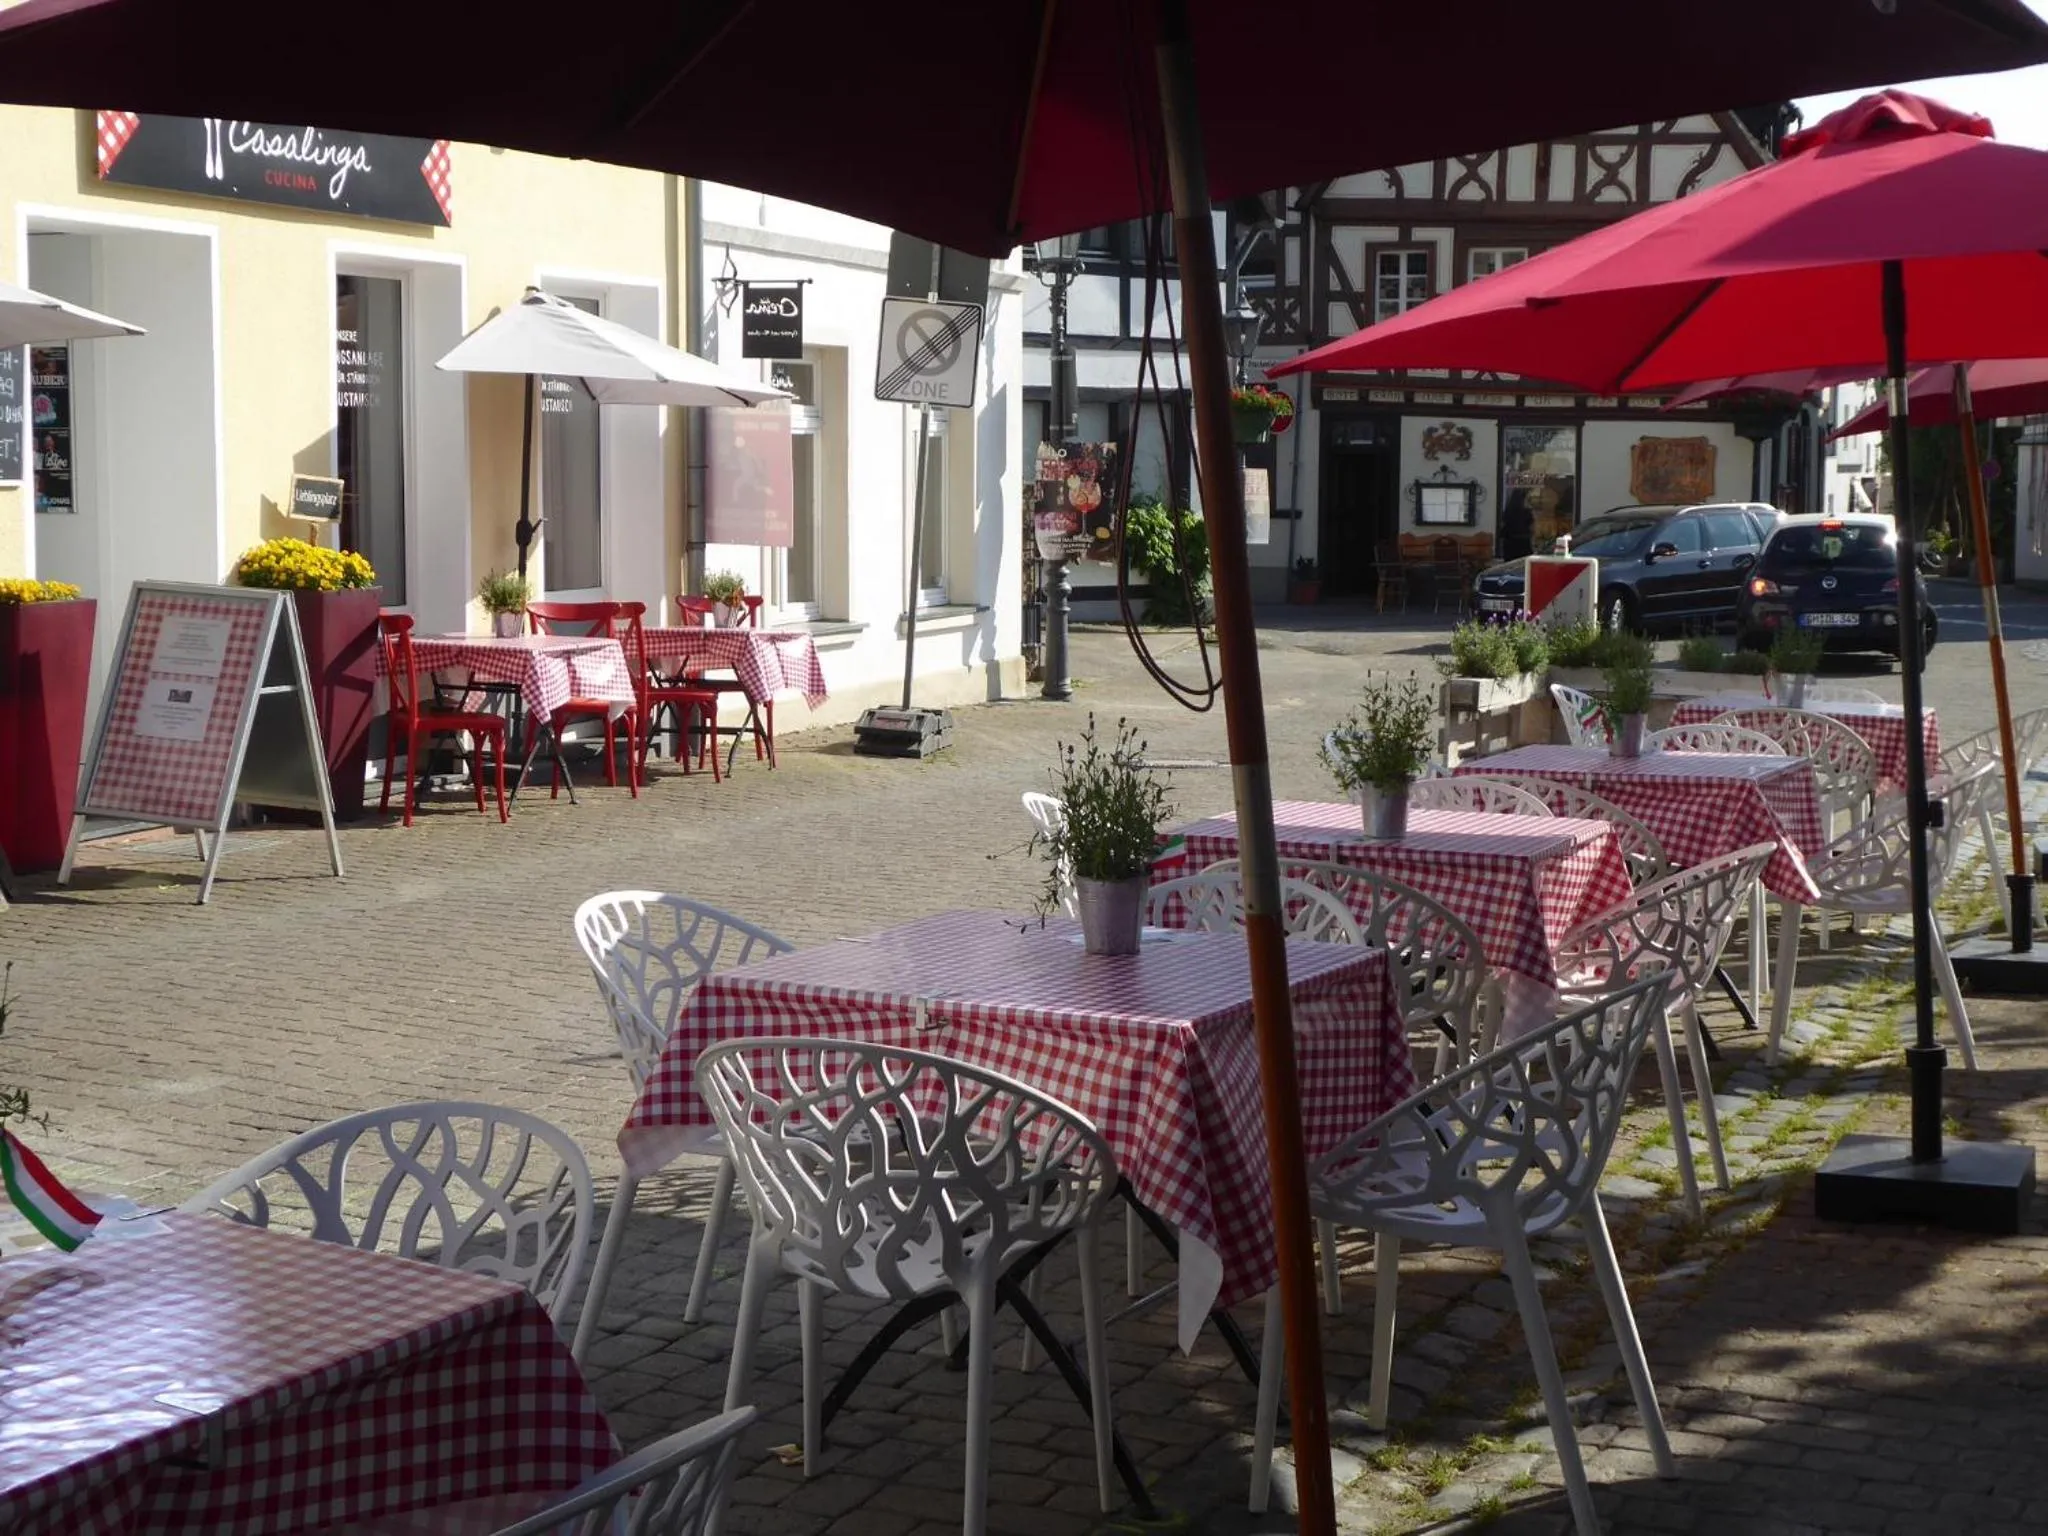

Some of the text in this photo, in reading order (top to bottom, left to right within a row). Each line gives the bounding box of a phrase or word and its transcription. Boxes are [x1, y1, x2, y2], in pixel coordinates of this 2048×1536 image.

[229, 121, 371, 199] Casalinga
[264, 170, 317, 192] CUCINA
[900, 379, 949, 399] ZONE
